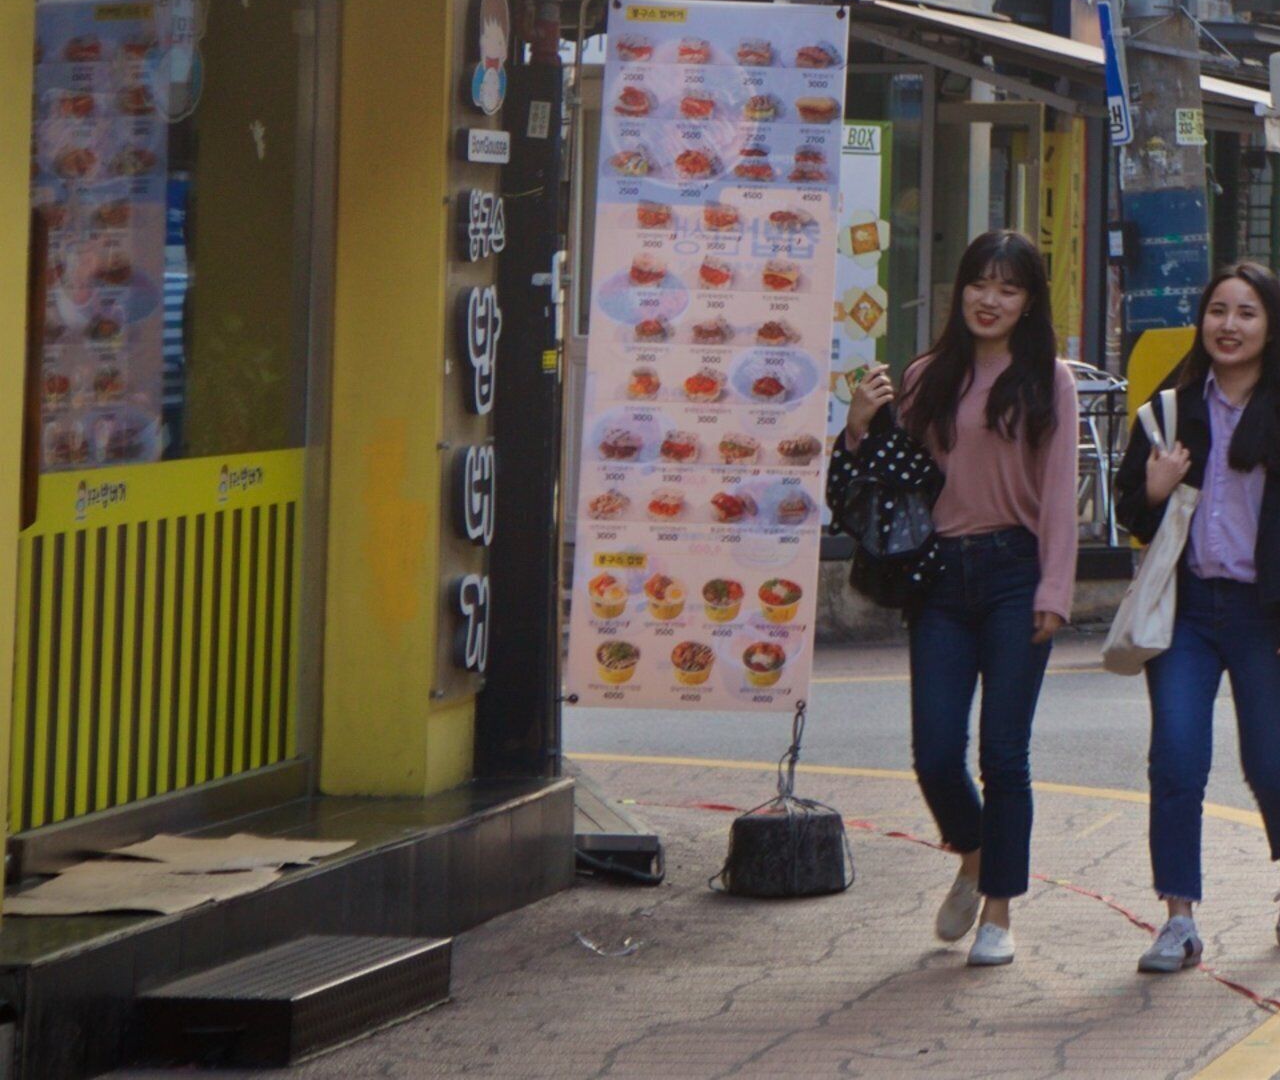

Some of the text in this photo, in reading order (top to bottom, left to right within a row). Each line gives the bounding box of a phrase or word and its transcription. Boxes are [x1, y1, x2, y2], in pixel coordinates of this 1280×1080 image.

[470, 135, 509, 158] BonGousse
[847, 128, 875, 149] BOX
[468, 188, 508, 263] 봉구스
[459, 283, 502, 673] 밥버거
